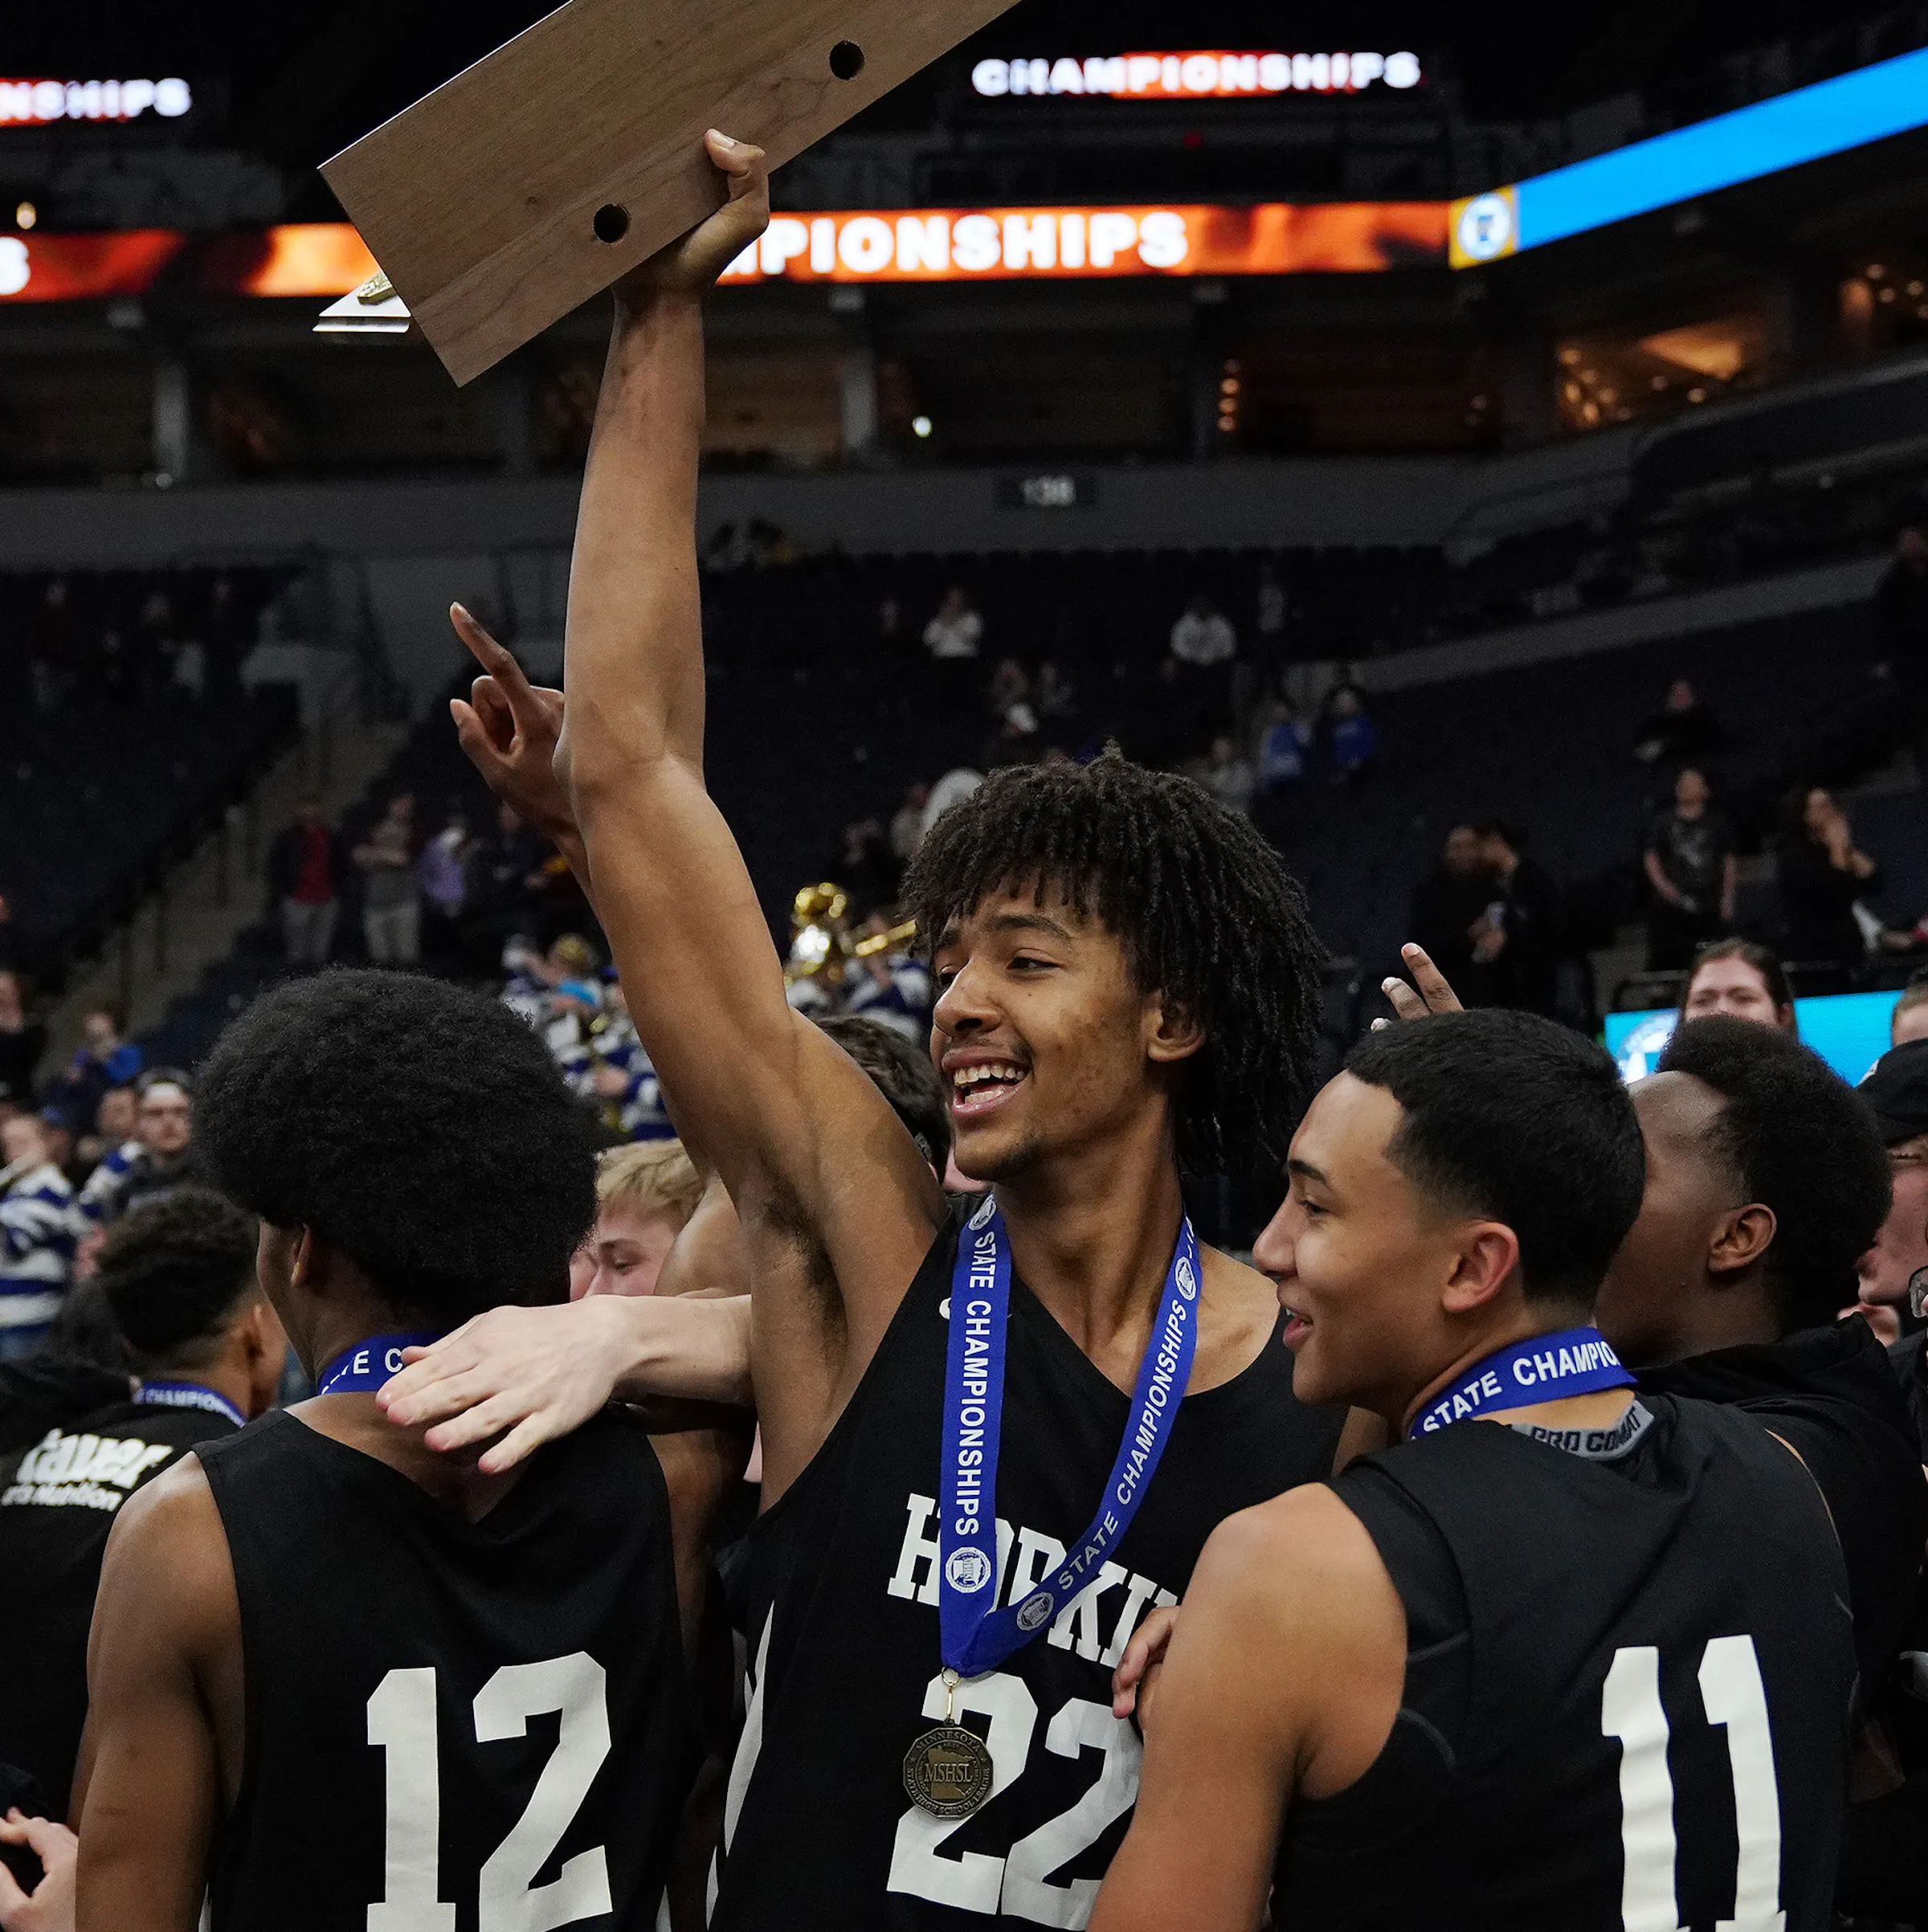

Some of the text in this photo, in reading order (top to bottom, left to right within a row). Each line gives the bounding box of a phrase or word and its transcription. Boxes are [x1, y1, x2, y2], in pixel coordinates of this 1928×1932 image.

[972, 52, 1420, 96] CHAMPIONSHIPS
[954, 1231, 997, 1536] STATE CHAMPIONSHIPS
[1058, 1298, 1187, 1591] STATE CHAMPIONSHIPS
[1422, 1341, 1621, 1432] STATE CHAMPIO
[1529, 1425, 1581, 1452] PRO
[366, 1651, 613, 1932] 12
[886, 1671, 1144, 1932] 22
[923, 1762, 974, 1783] MSHSL
[1601, 1633, 1787, 1932] 11
